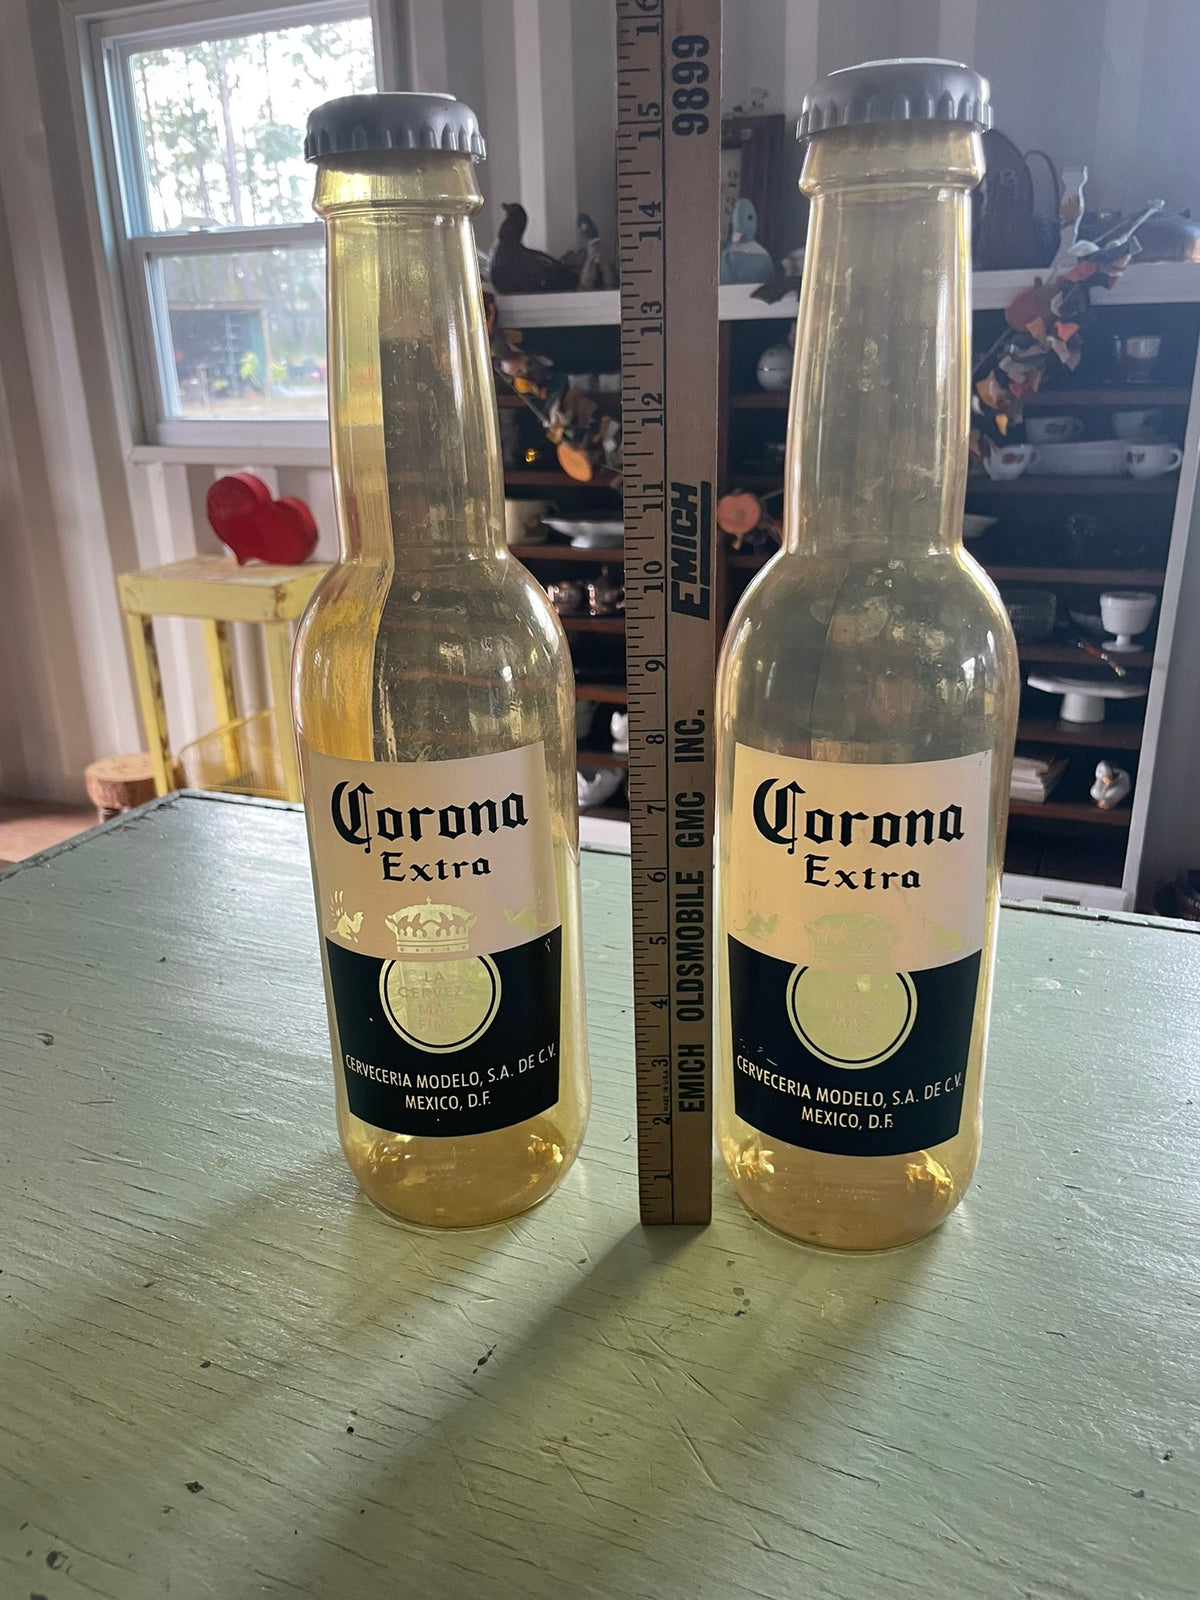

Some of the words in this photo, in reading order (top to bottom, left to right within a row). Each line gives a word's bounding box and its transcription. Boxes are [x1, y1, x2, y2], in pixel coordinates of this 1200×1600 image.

[671, 35, 710, 137] 9899
[638, 102, 661, 141] 15
[639, 201, 662, 241] 14
[641, 301, 663, 335] 13
[642, 392, 663, 427] 12
[643, 480, 664, 513] 11
[671, 481, 711, 620] EMICH
[643, 560, 664, 594] 10
[645, 659, 666, 673] 9
[646, 733, 665, 745] 8
[675, 709, 705, 763] INC.
[331, 781, 529, 854] Corona
[647, 804, 666, 815] 7
[675, 791, 706, 848] GMC
[753, 778, 965, 855] Corona
[380, 851, 492, 882] Extra
[647, 871, 666, 883] 6
[804, 853, 922, 890] Extra
[649, 936, 667, 946] 5
[675, 870, 705, 1022] OLDSMOBILE
[650, 998, 668, 1010] 4
[345, 1054, 412, 1088] CERVECERIA
[416, 1071, 484, 1089] MODELO,
[488, 1066, 514, 1083] S.A.
[518, 1055, 535, 1073] DE
[651, 1058, 669, 1068] 3
[678, 1044, 706, 1112] EMICH
[736, 1054, 811, 1099] CERVECERIA
[816, 1088, 888, 1109] MODELO,
[892, 1089, 919, 1106] S.A.
[924, 1081, 941, 1100] DE
[405, 1094, 463, 1111] MEXICO,
[468, 1091, 491, 1108] D.F.
[801, 1106, 863, 1130] MEXICO,
[652, 1116, 670, 1126] 2
[654, 1172, 672, 1182] 1
